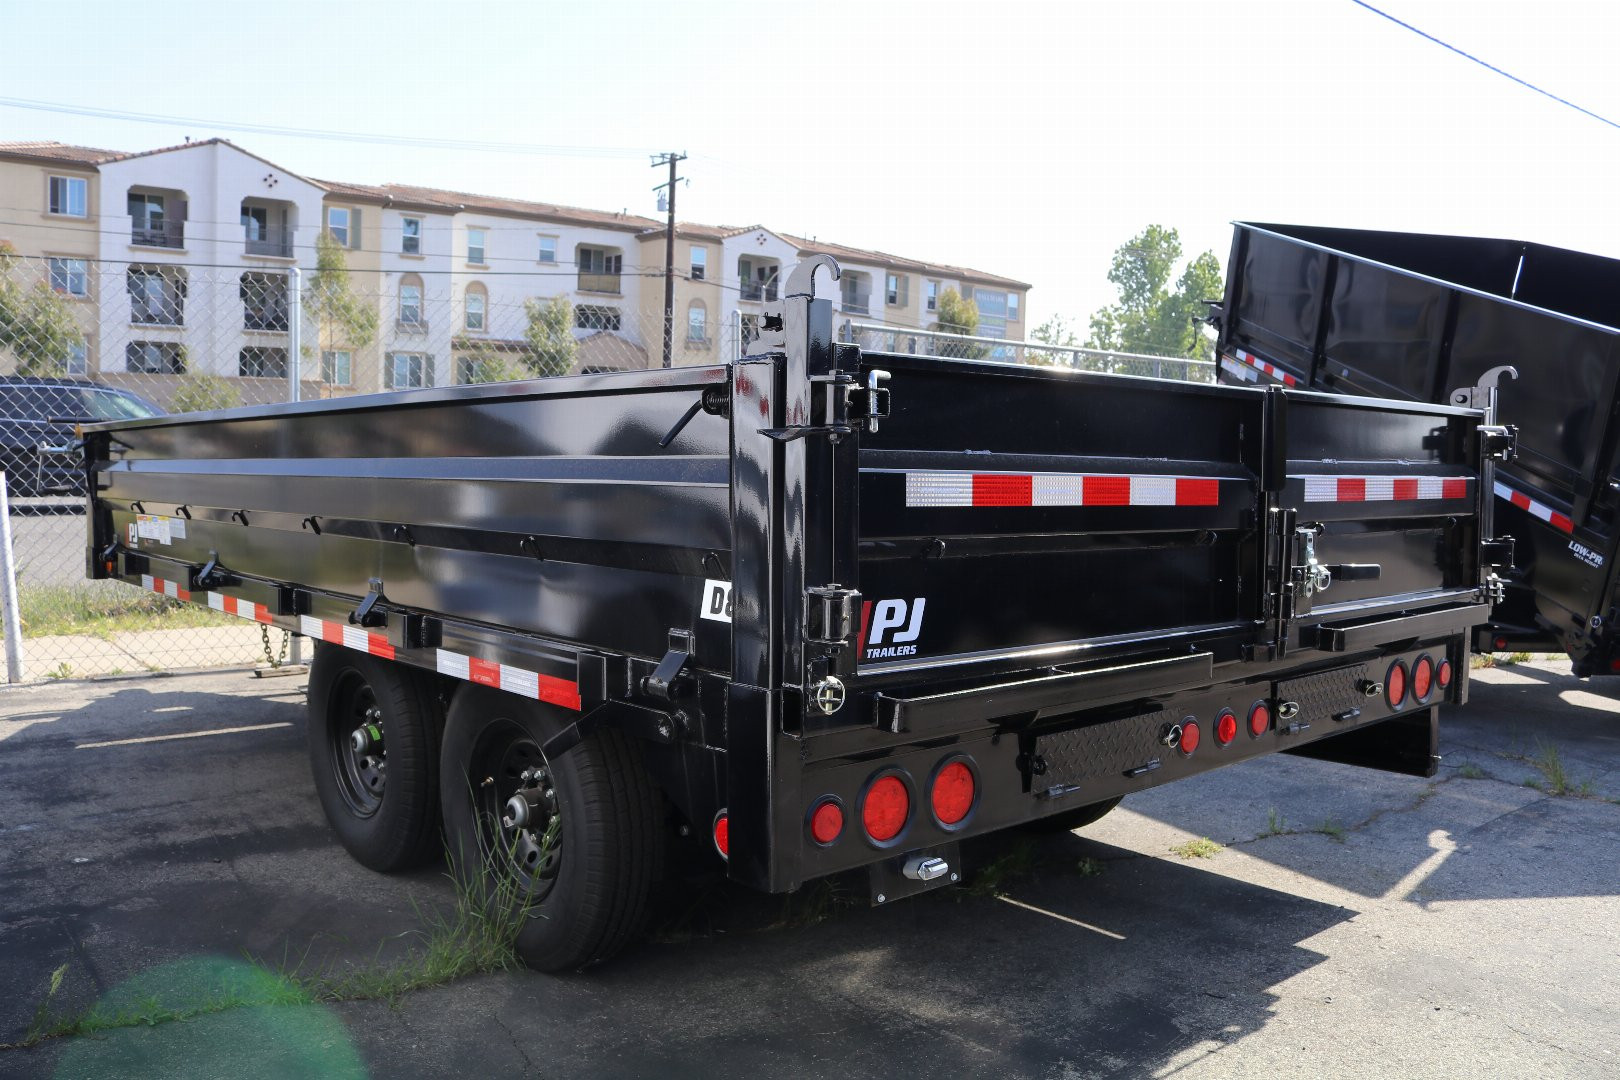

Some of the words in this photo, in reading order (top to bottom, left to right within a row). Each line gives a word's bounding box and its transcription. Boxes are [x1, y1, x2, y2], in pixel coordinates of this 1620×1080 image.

[1568, 540, 1603, 565] LOW-PR
[869, 597, 926, 645] PJ
[867, 645, 917, 659] TRAILERS
